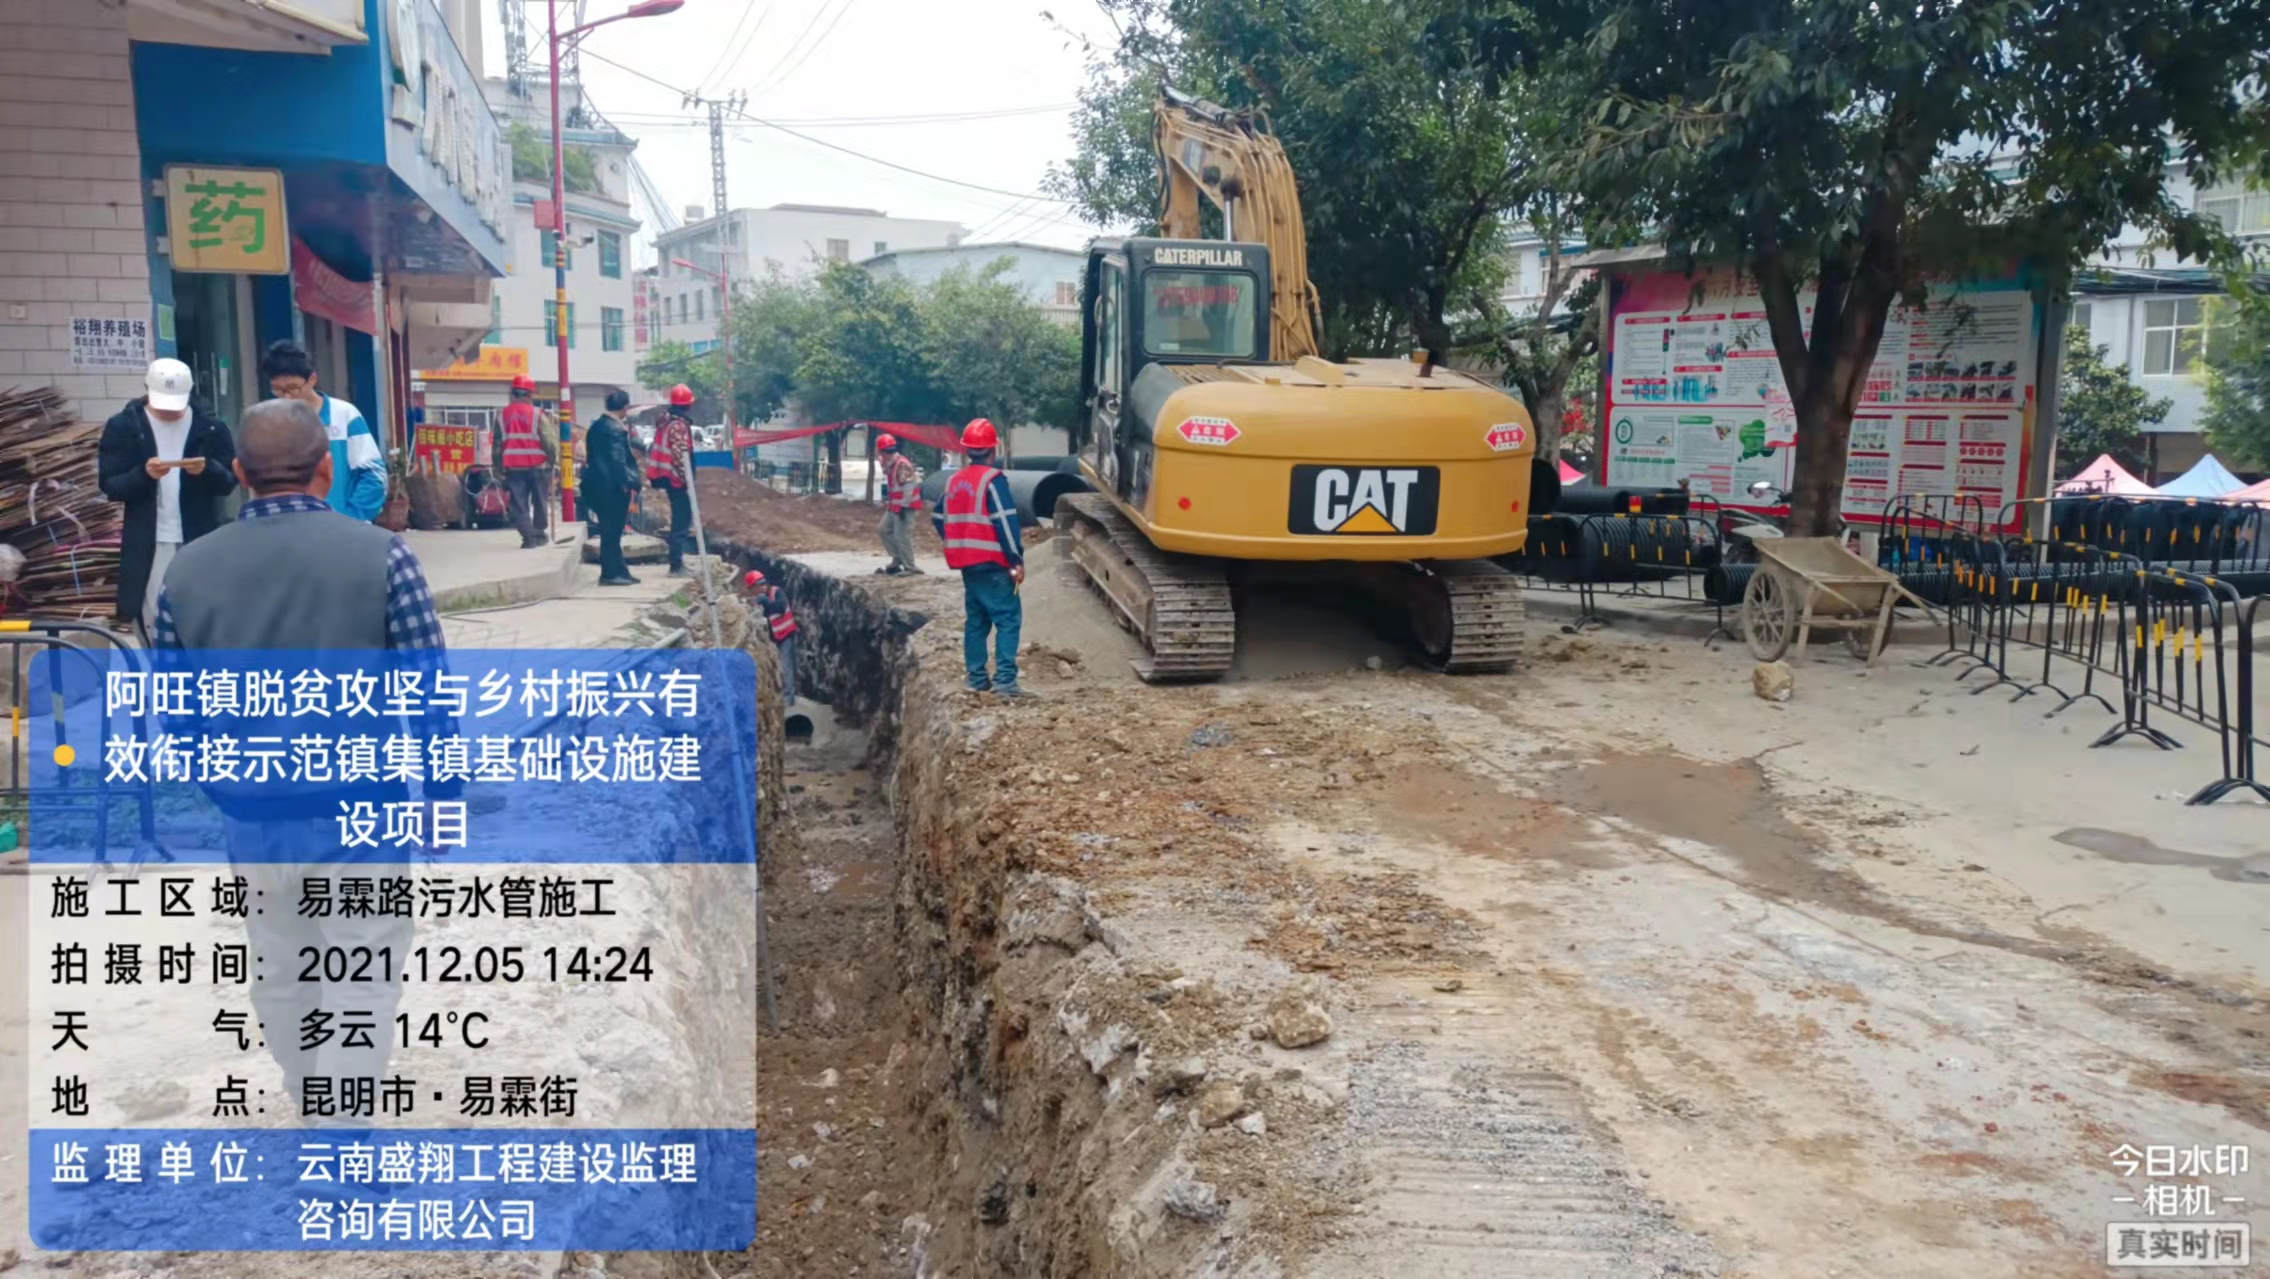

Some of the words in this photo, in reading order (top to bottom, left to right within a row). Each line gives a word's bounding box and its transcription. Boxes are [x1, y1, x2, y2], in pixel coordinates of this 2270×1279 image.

[185, 180, 266, 254] 药
[1154, 247, 1243, 266] CATERPILLAR
[73, 318, 146, 337] 裕翔养殖场
[1313, 468, 1419, 532] CAT
